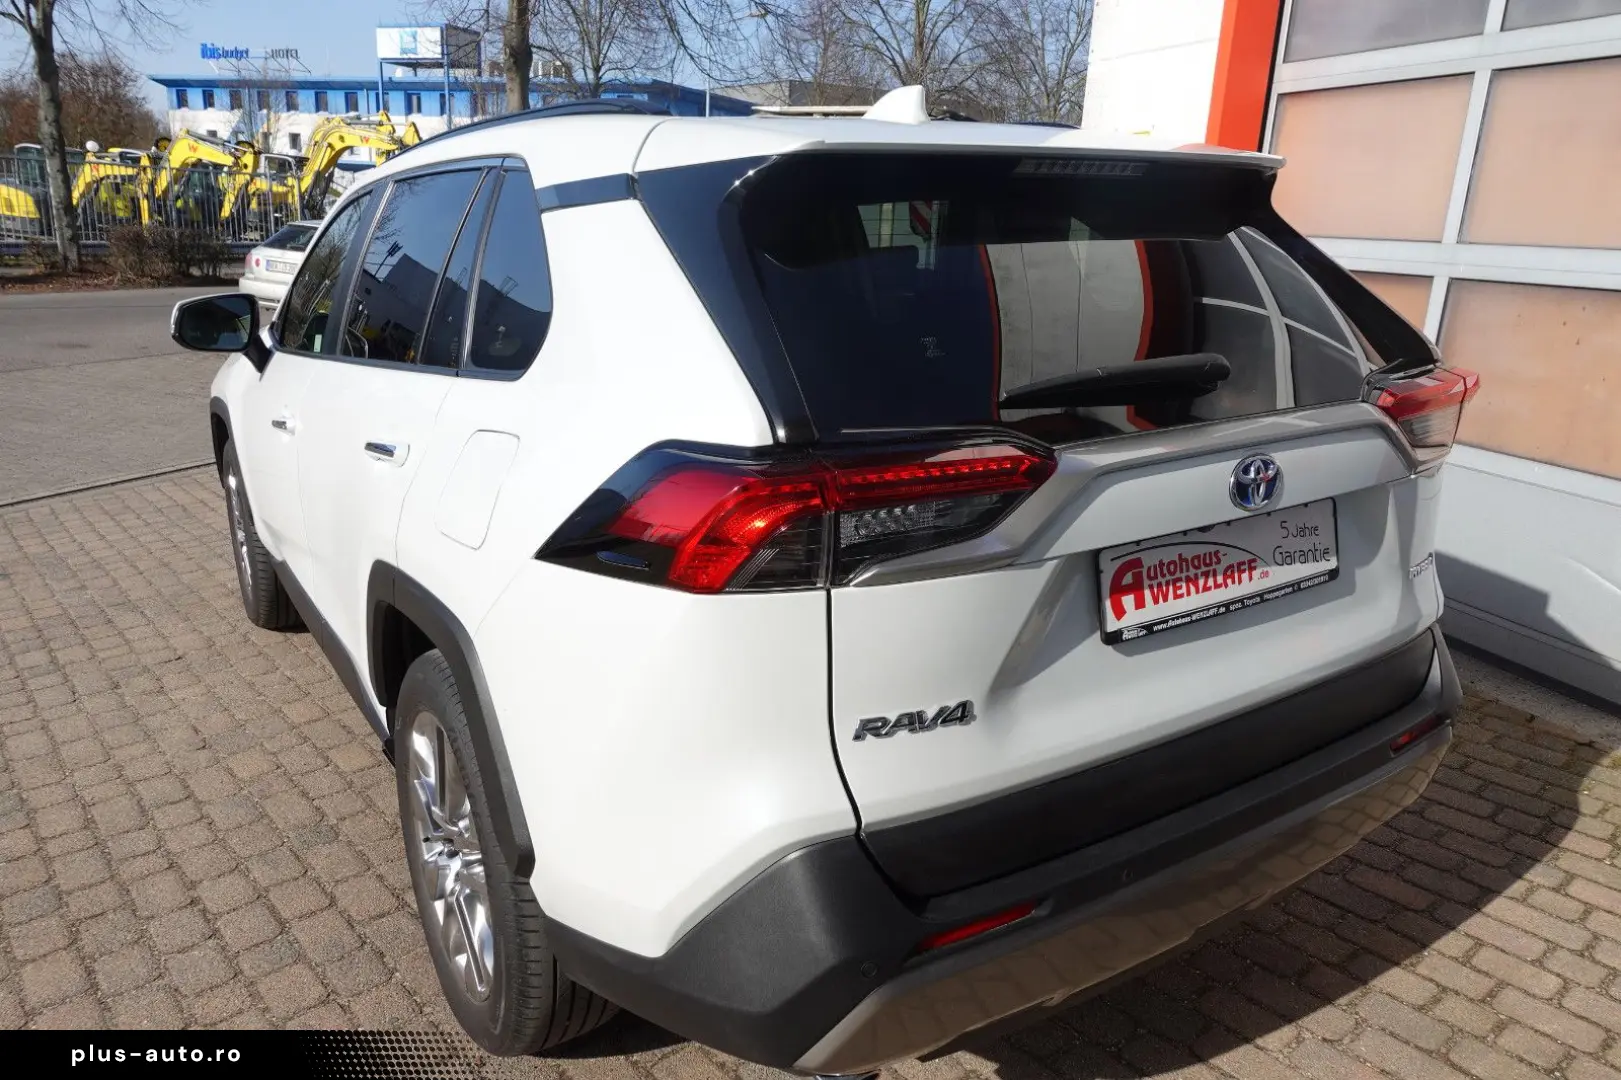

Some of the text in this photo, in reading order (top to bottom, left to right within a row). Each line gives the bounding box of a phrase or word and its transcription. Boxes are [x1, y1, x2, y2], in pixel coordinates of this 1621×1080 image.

[201, 43, 220, 60] ibis
[1280, 520, 1320, 539] 5 Jahre
[1272, 542, 1331, 567] Garantie
[852, 699, 977, 742] RAV4
